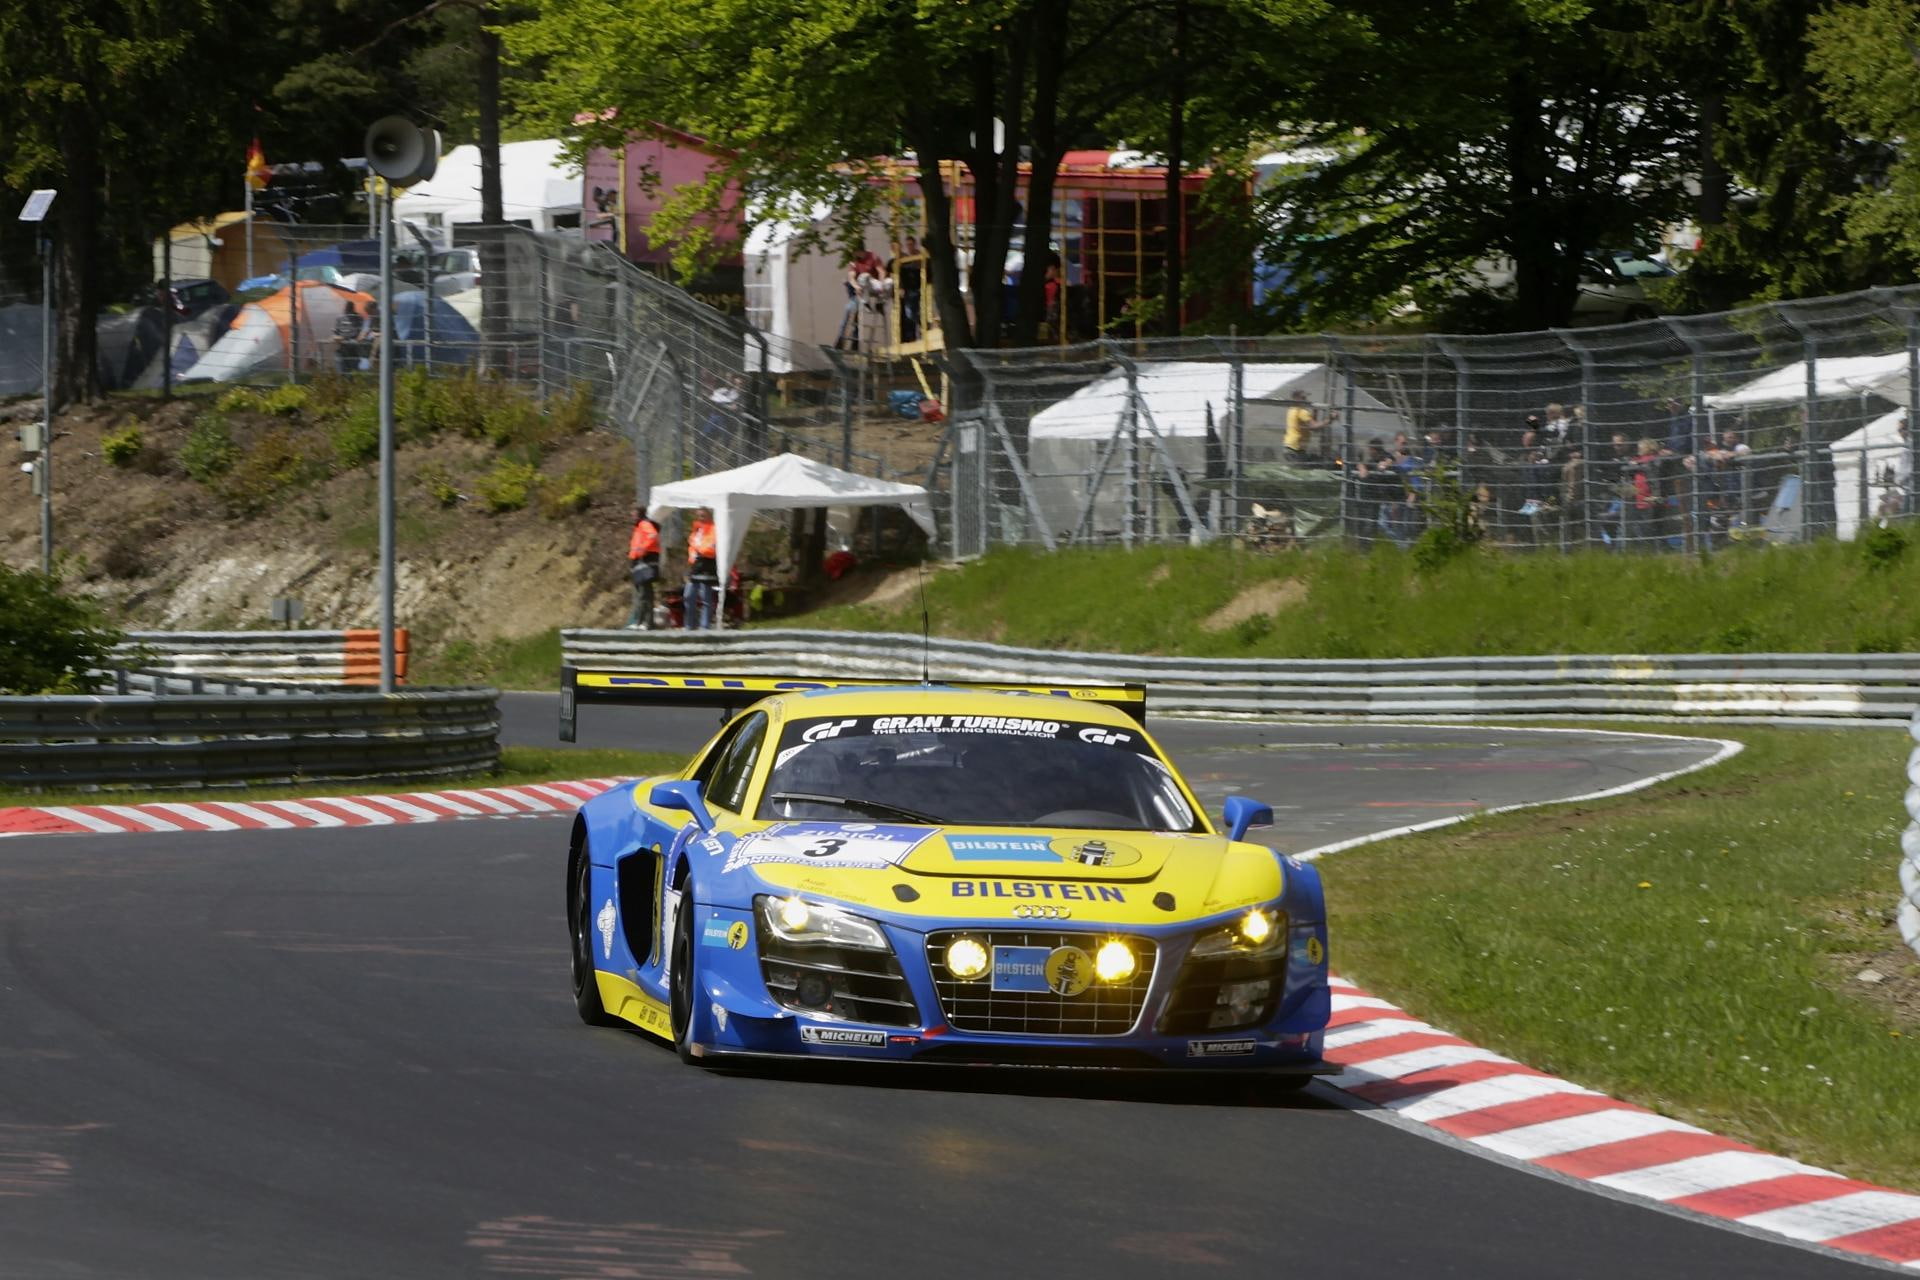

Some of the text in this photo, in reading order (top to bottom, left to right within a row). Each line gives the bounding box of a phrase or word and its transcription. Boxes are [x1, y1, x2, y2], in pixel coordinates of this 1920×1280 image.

[872, 716, 1061, 733] GRAN TURISMO
[985, 728, 1056, 738] SIMULATOR
[800, 829, 894, 841] ZURICH
[803, 838, 849, 858] 3
[951, 840, 1047, 851] BILSTEIN
[951, 881, 1126, 904] BILSTEIN
[995, 962, 1044, 976] BILSTEIN
[820, 1031, 883, 1043] MICHELIN
[1206, 1042, 1253, 1052] MICHELIN
